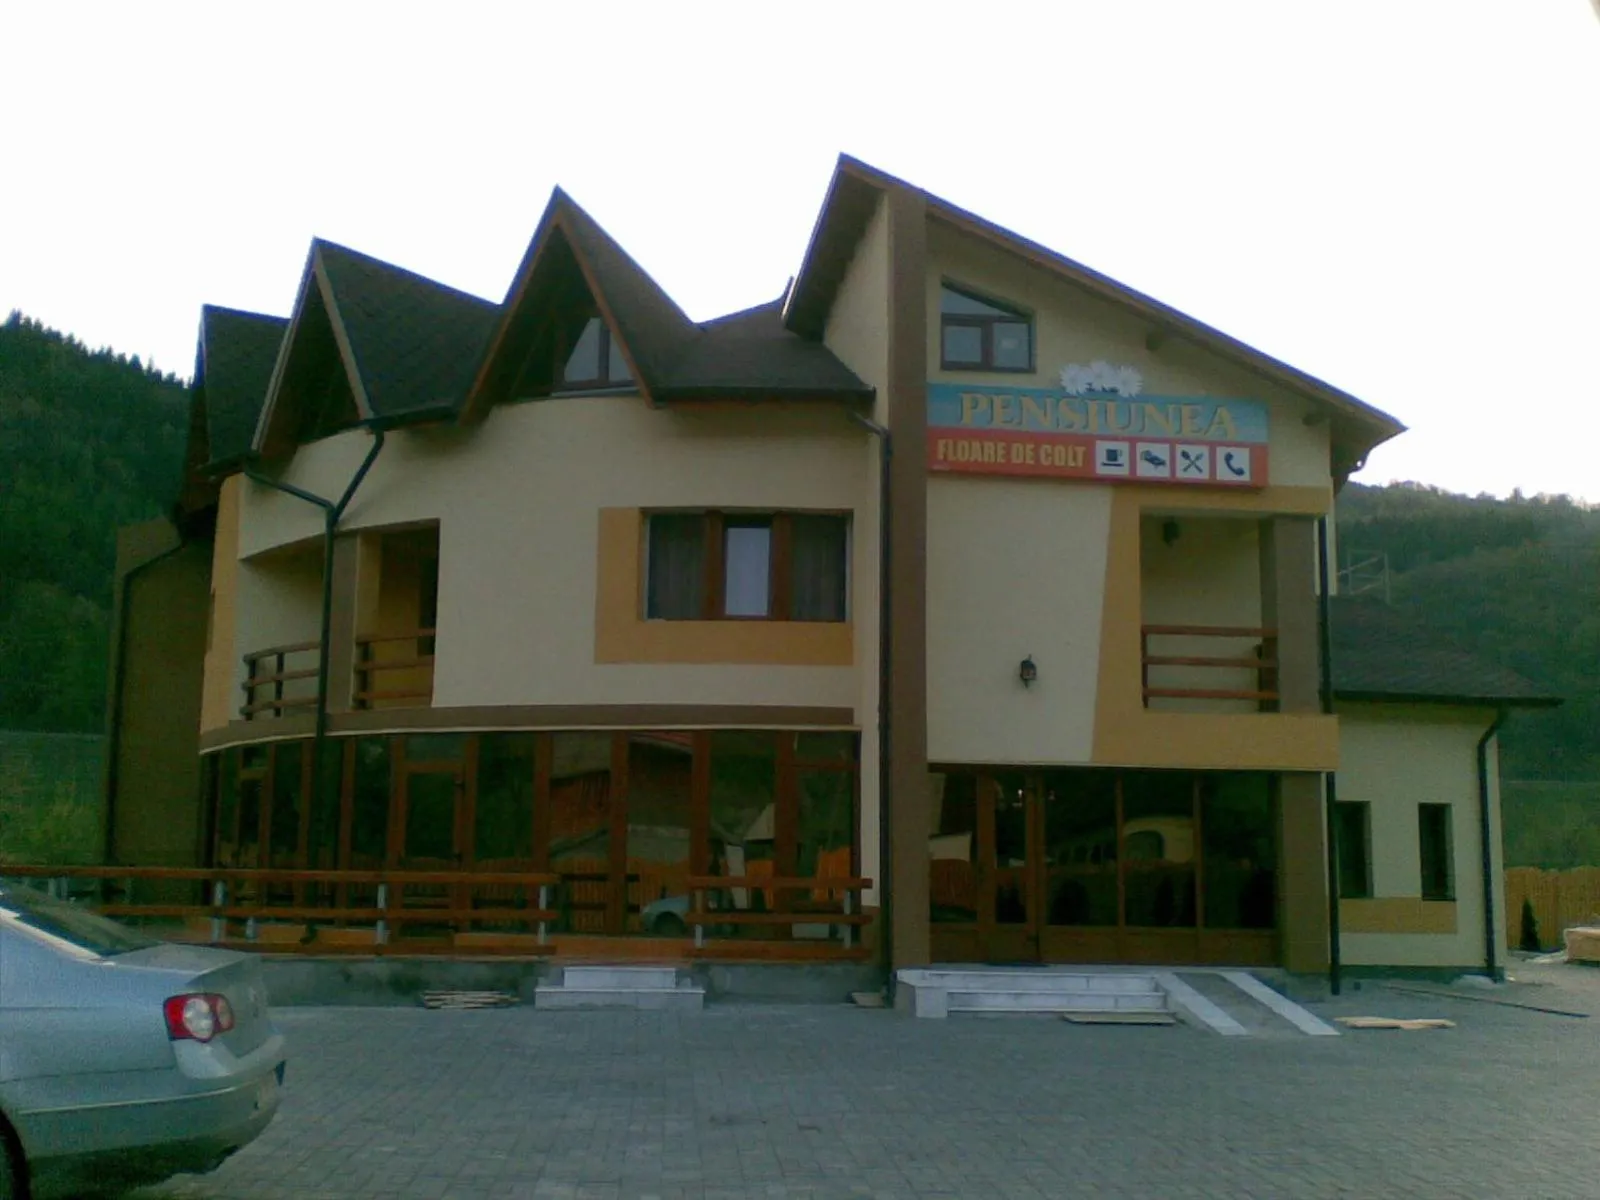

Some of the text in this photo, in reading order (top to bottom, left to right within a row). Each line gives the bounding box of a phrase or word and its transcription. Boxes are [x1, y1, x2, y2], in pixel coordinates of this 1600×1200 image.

[959, 392, 1238, 439] PENSIUNEA
[937, 438, 1006, 463] FLOARE
[1010, 442, 1035, 465] DE
